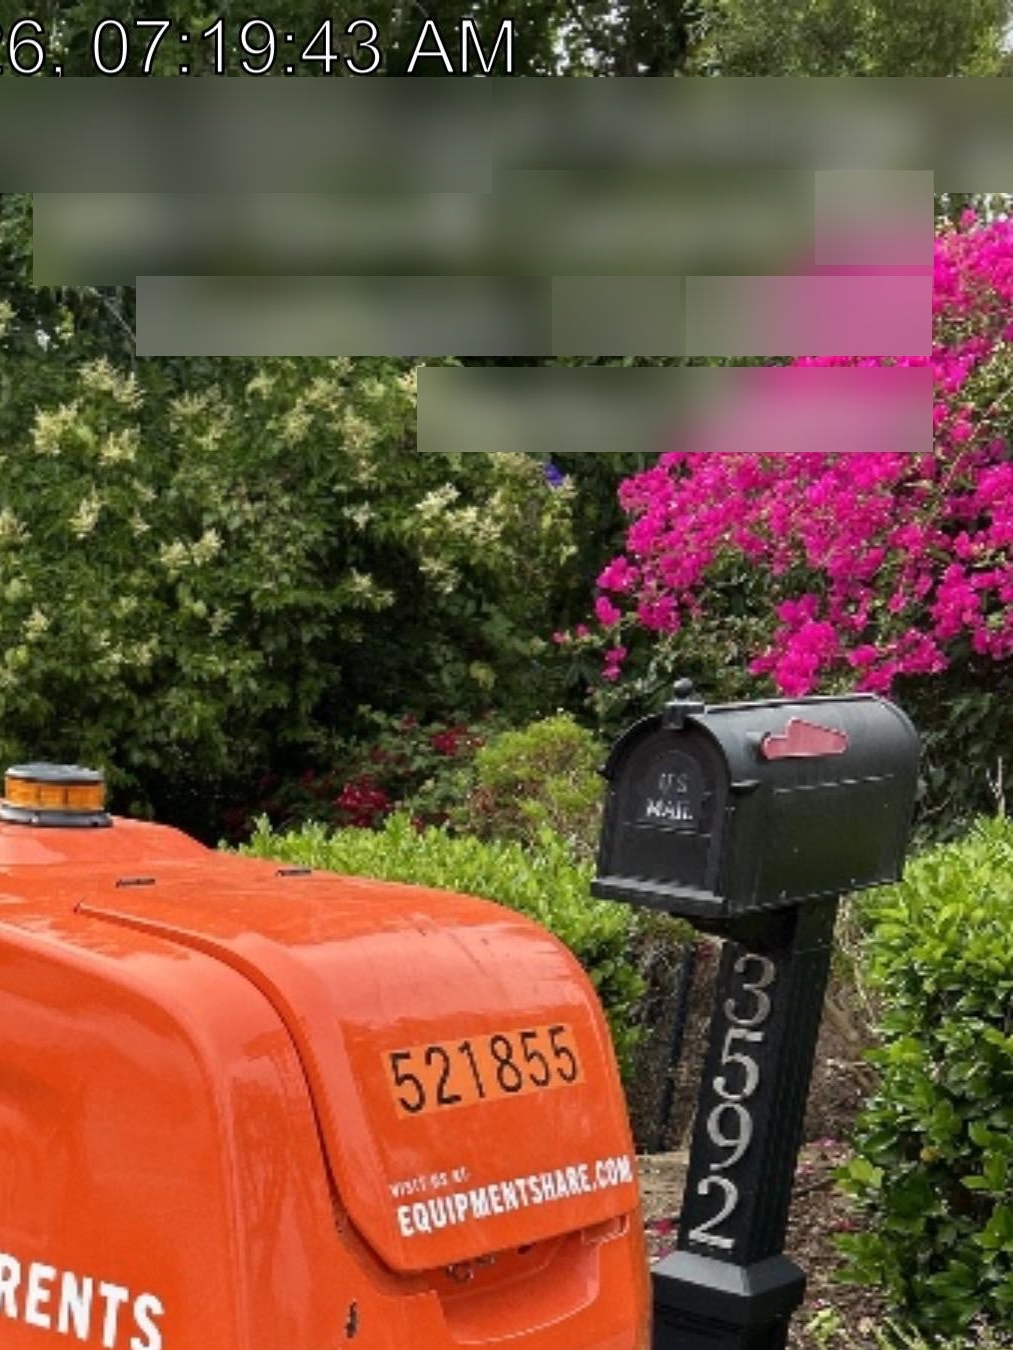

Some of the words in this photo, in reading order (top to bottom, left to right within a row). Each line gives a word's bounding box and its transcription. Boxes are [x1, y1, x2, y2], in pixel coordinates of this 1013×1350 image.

[646, 798, 694, 820] MAIL
[390, 1025, 578, 1114] 521855
[689, 953, 777, 1249] 3592
[397, 1154, 633, 1237] EQUIPMENTSHARE.COM
